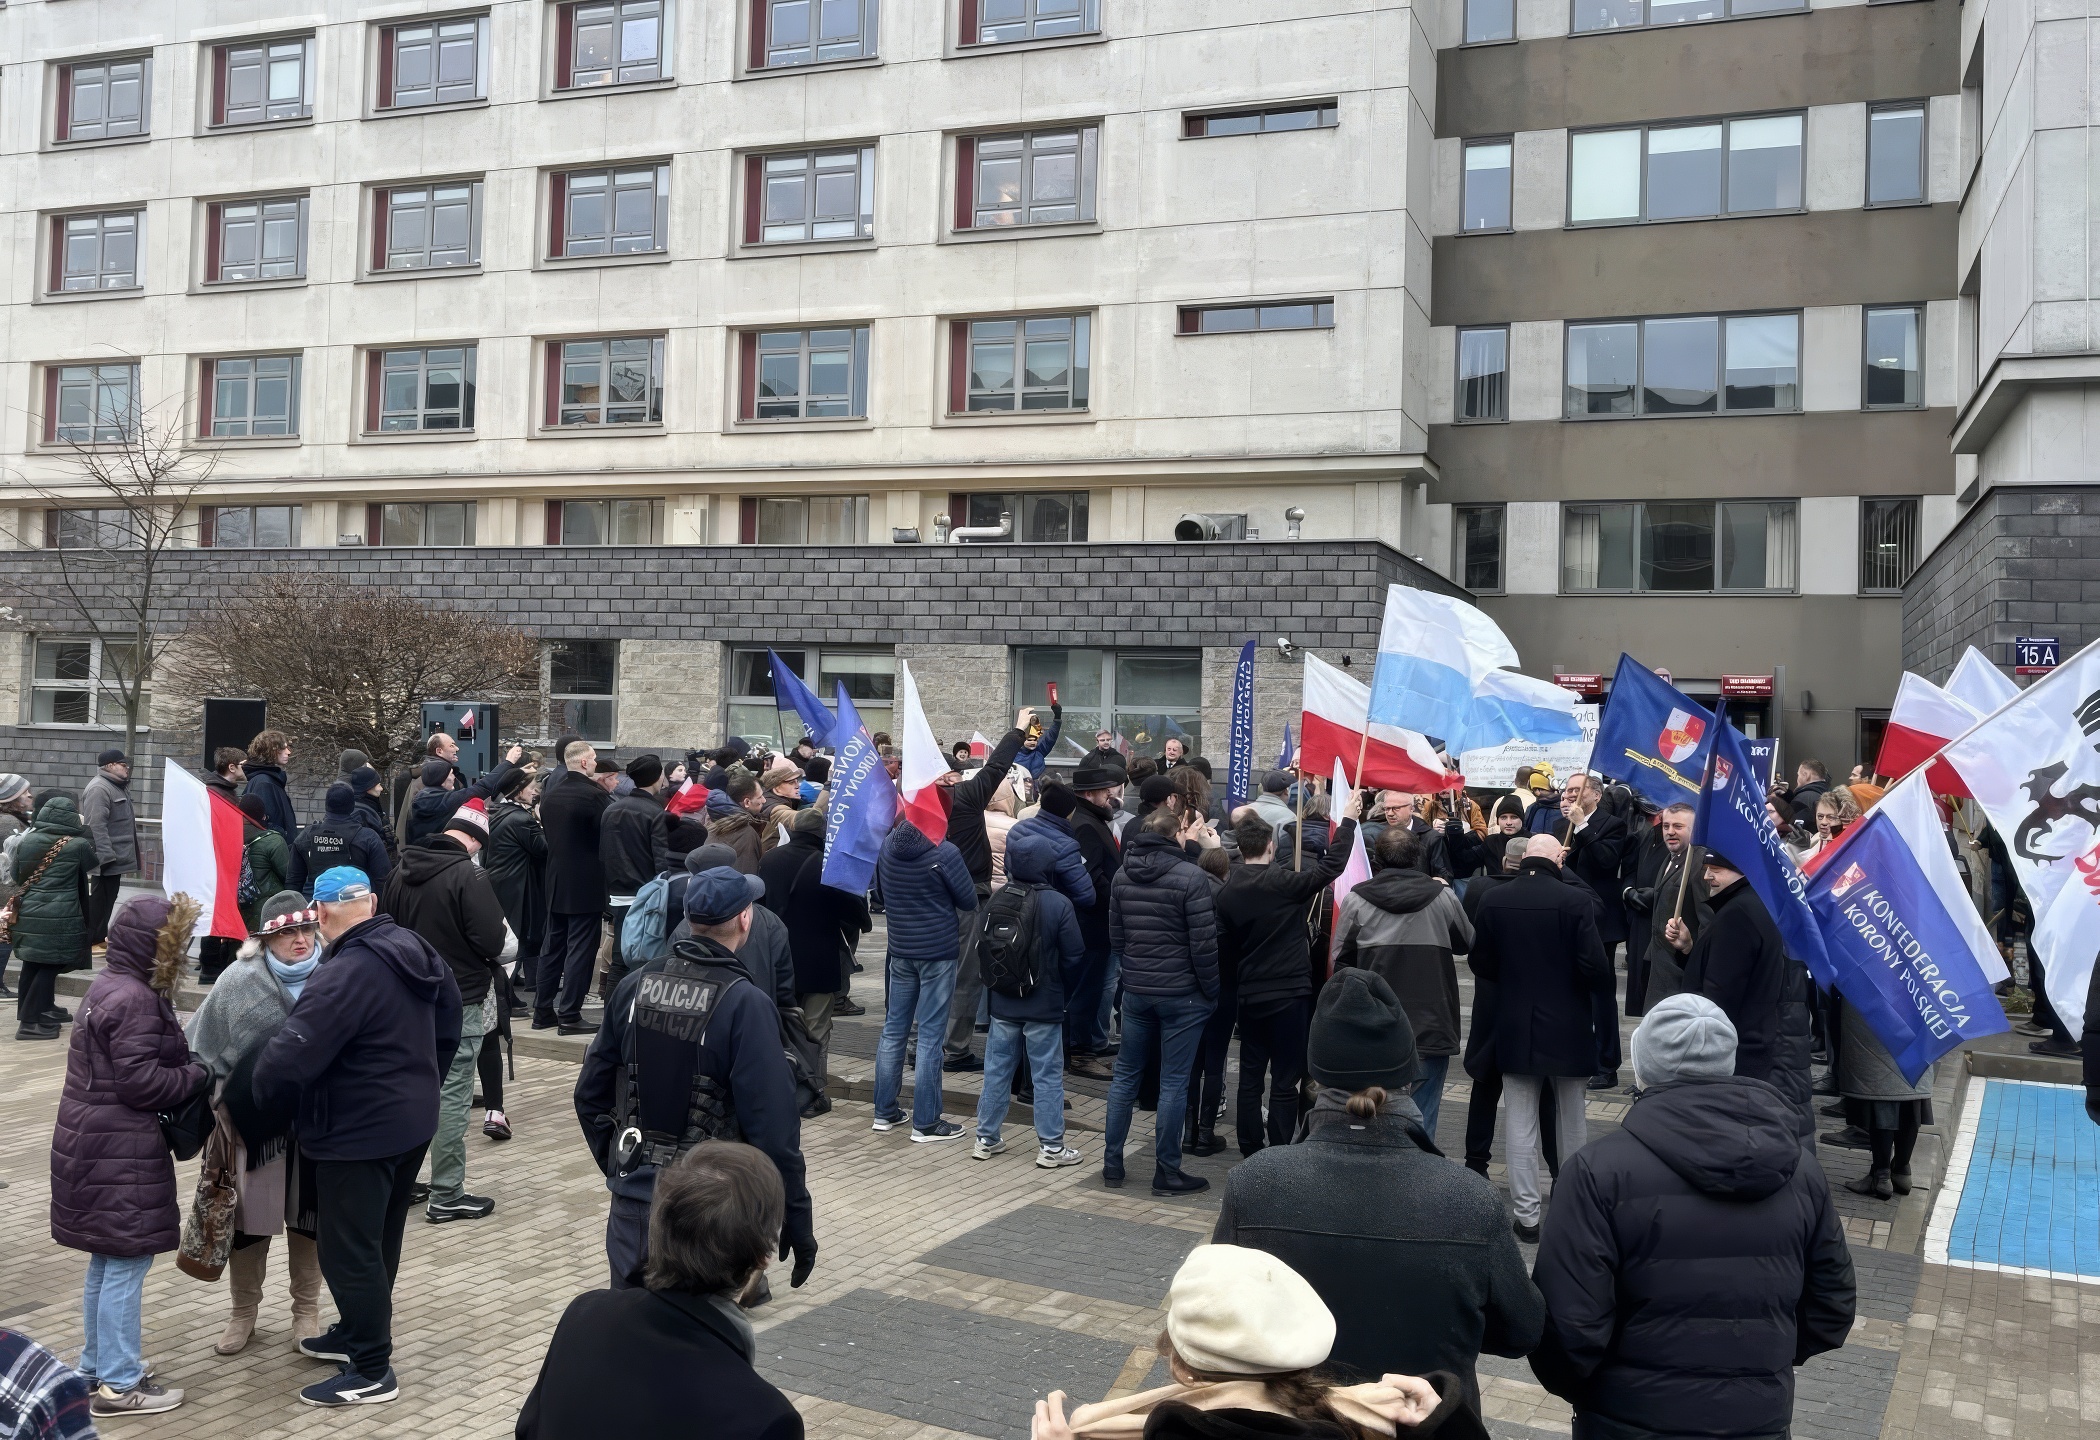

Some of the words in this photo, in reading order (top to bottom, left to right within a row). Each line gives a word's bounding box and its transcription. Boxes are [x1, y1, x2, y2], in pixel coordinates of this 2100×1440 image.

[2021, 645, 2039, 665] 15
[2041, 645, 2056, 665] A
[636, 977, 710, 1012] POLICJA
[1843, 903, 1903, 969] KORONY
[1899, 967, 1953, 1040] POLSKIEJ
[1862, 889, 1971, 1029] KONFEDERACJA
